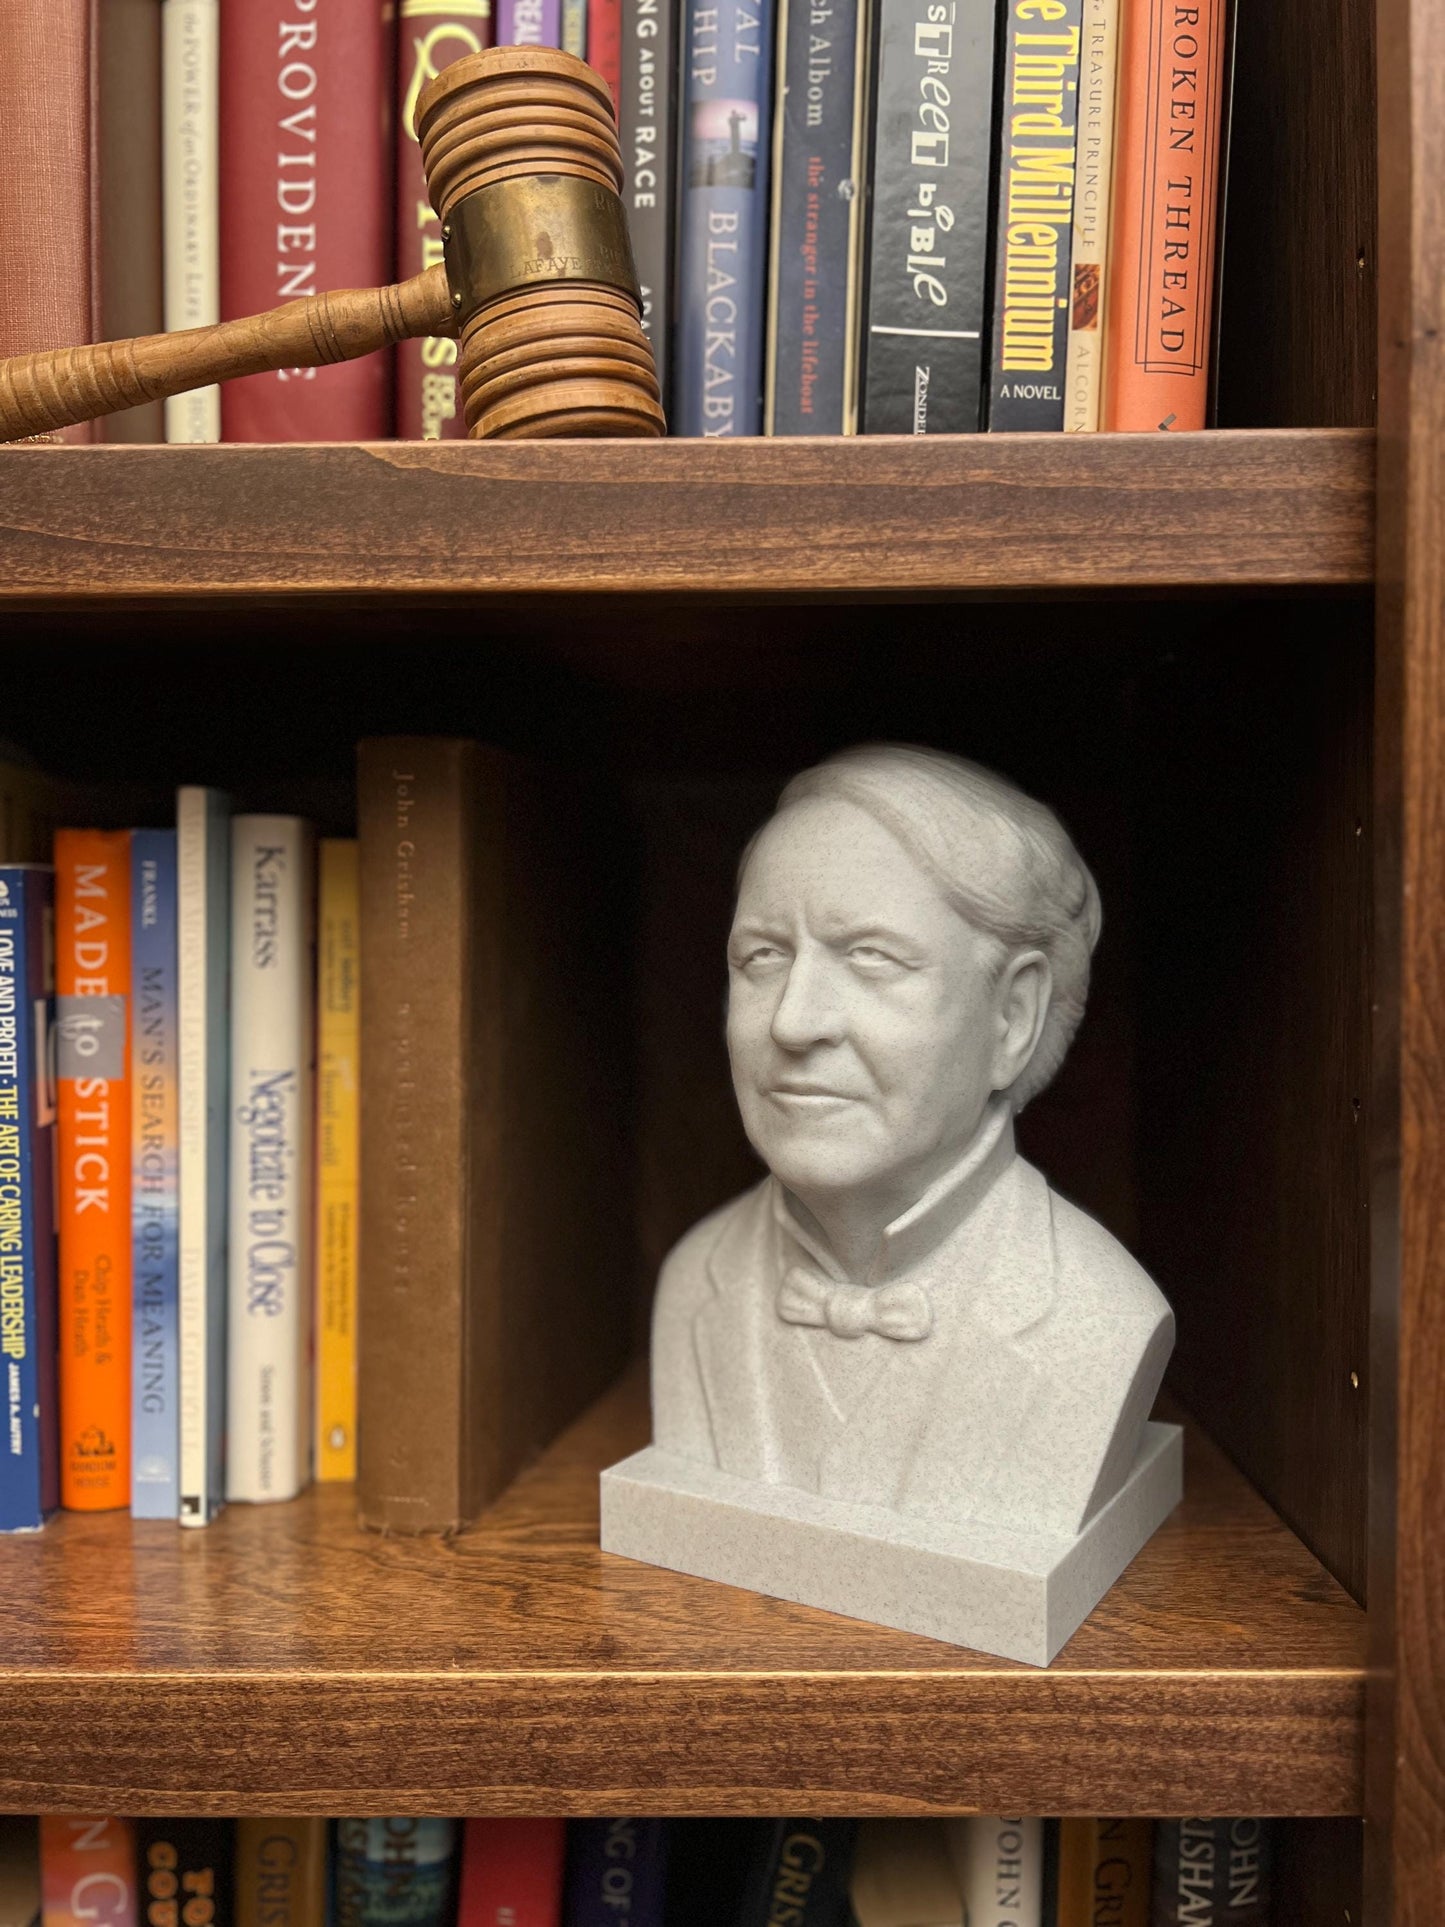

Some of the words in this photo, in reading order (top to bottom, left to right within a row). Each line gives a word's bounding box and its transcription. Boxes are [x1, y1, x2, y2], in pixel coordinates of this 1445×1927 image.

[639, 48, 655, 116] ABOUT
[806, 35, 832, 128] Albom
[1010, 25, 1081, 137] Third
[1086, 19, 1106, 129] TREASURE
[634, 126, 658, 209] RACE
[806, 156, 824, 188] the
[1082, 138, 1101, 249] PRINCIPLE
[800, 192, 823, 274] stranger
[1001, 144, 1076, 372] Millennium
[1160, 176, 1193, 353] THREAD
[802, 305, 819, 336] the
[803, 280, 819, 300] in
[799, 341, 820, 415] lifeboat
[1000, 384, 1011, 399] A
[1013, 384, 1062, 401] NOVEL
[73, 864, 109, 998] MADE
[252, 845, 288, 970] Karrass
[75, 1018, 104, 1056] to
[141, 966, 166, 1066] MAN'S
[0, 1085, 19, 1120] THE
[0, 1123, 20, 1158] ART
[140, 1075, 166, 1194] SEARCH
[236, 1068, 298, 1202] Negotiate
[0, 1159, 21, 1183] OF
[73, 1077, 109, 1215] STICK
[0, 1185, 23, 1251] CARING
[140, 1204, 166, 1260] FOR
[247, 1208, 291, 1238] to
[0, 1255, 26, 1360] LEADERSHIP
[246, 1240, 297, 1318] Close
[140, 1271, 166, 1414] MEANING
